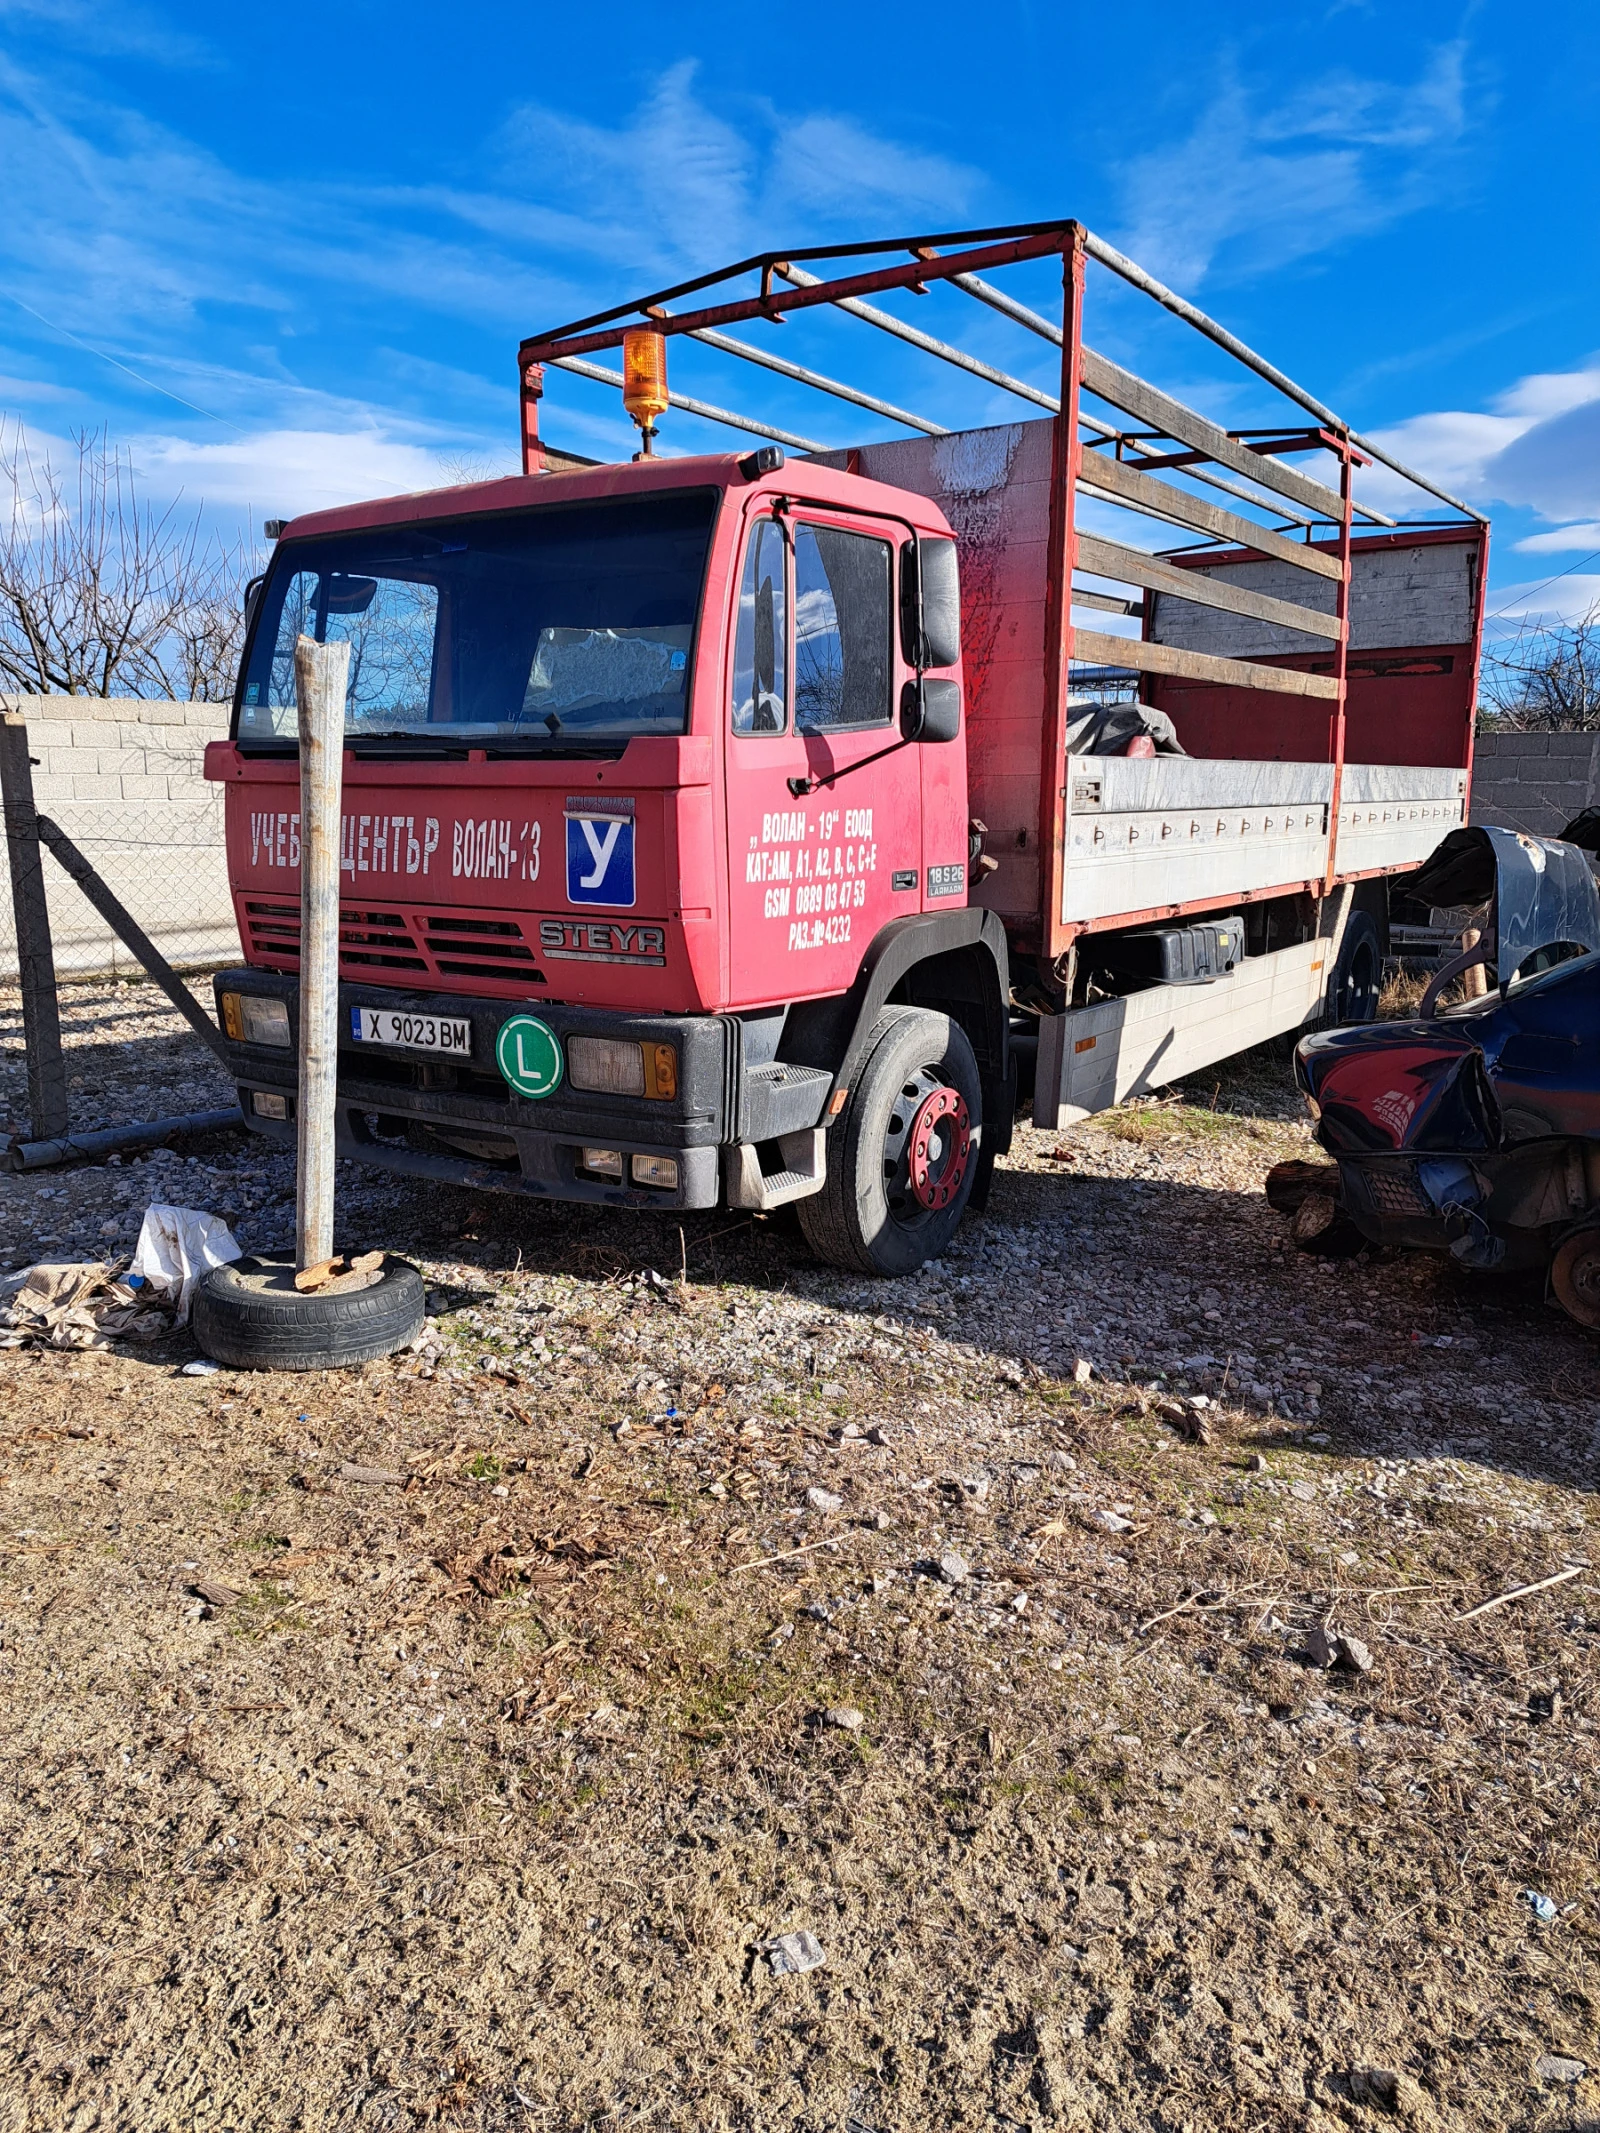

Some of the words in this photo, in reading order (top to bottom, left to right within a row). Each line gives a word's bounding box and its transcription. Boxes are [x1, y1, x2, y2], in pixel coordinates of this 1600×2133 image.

[844, 808, 873, 842] ЕООД
[250, 812, 301, 867] УЧЕБ
[341, 814, 440, 882] ЦЕНТЪР
[764, 887, 791, 919] GSM
[796, 884, 823, 915] 0889
[824, 882, 838, 911] 03
[839, 881, 852, 909] 47
[853, 879, 866, 907] 53
[540, 920, 664, 953] STEYR
[391, 1016, 436, 1046] 9023
[440, 1022, 466, 1050] BM
[517, 1033, 542, 1080] L
